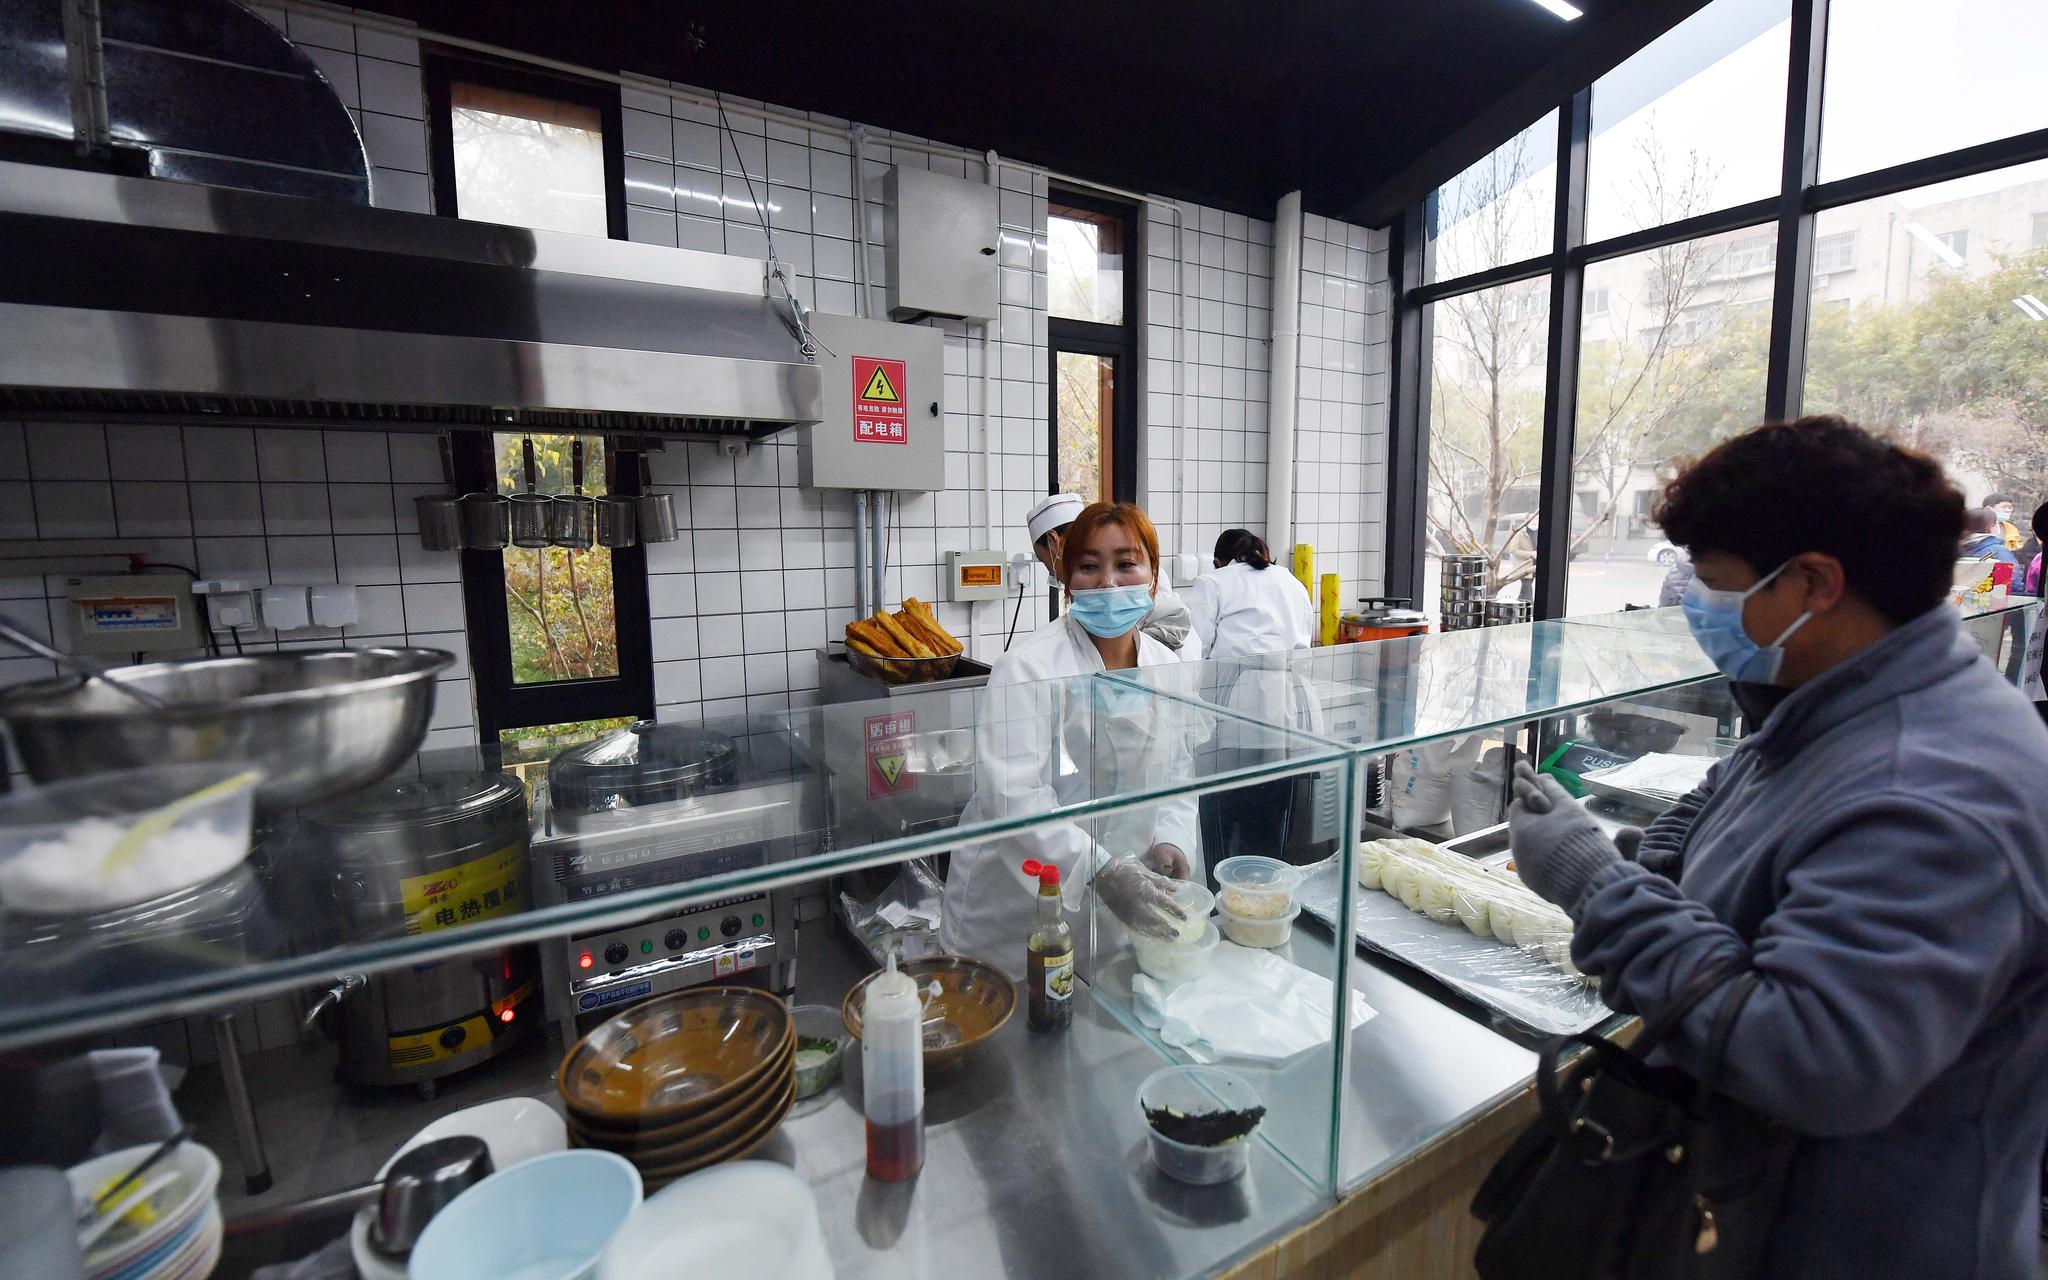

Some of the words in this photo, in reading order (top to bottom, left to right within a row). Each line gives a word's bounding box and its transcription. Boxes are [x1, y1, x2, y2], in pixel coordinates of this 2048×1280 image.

[860, 421, 902, 437] 配电箱
[435, 877, 520, 926] 电热覆底
